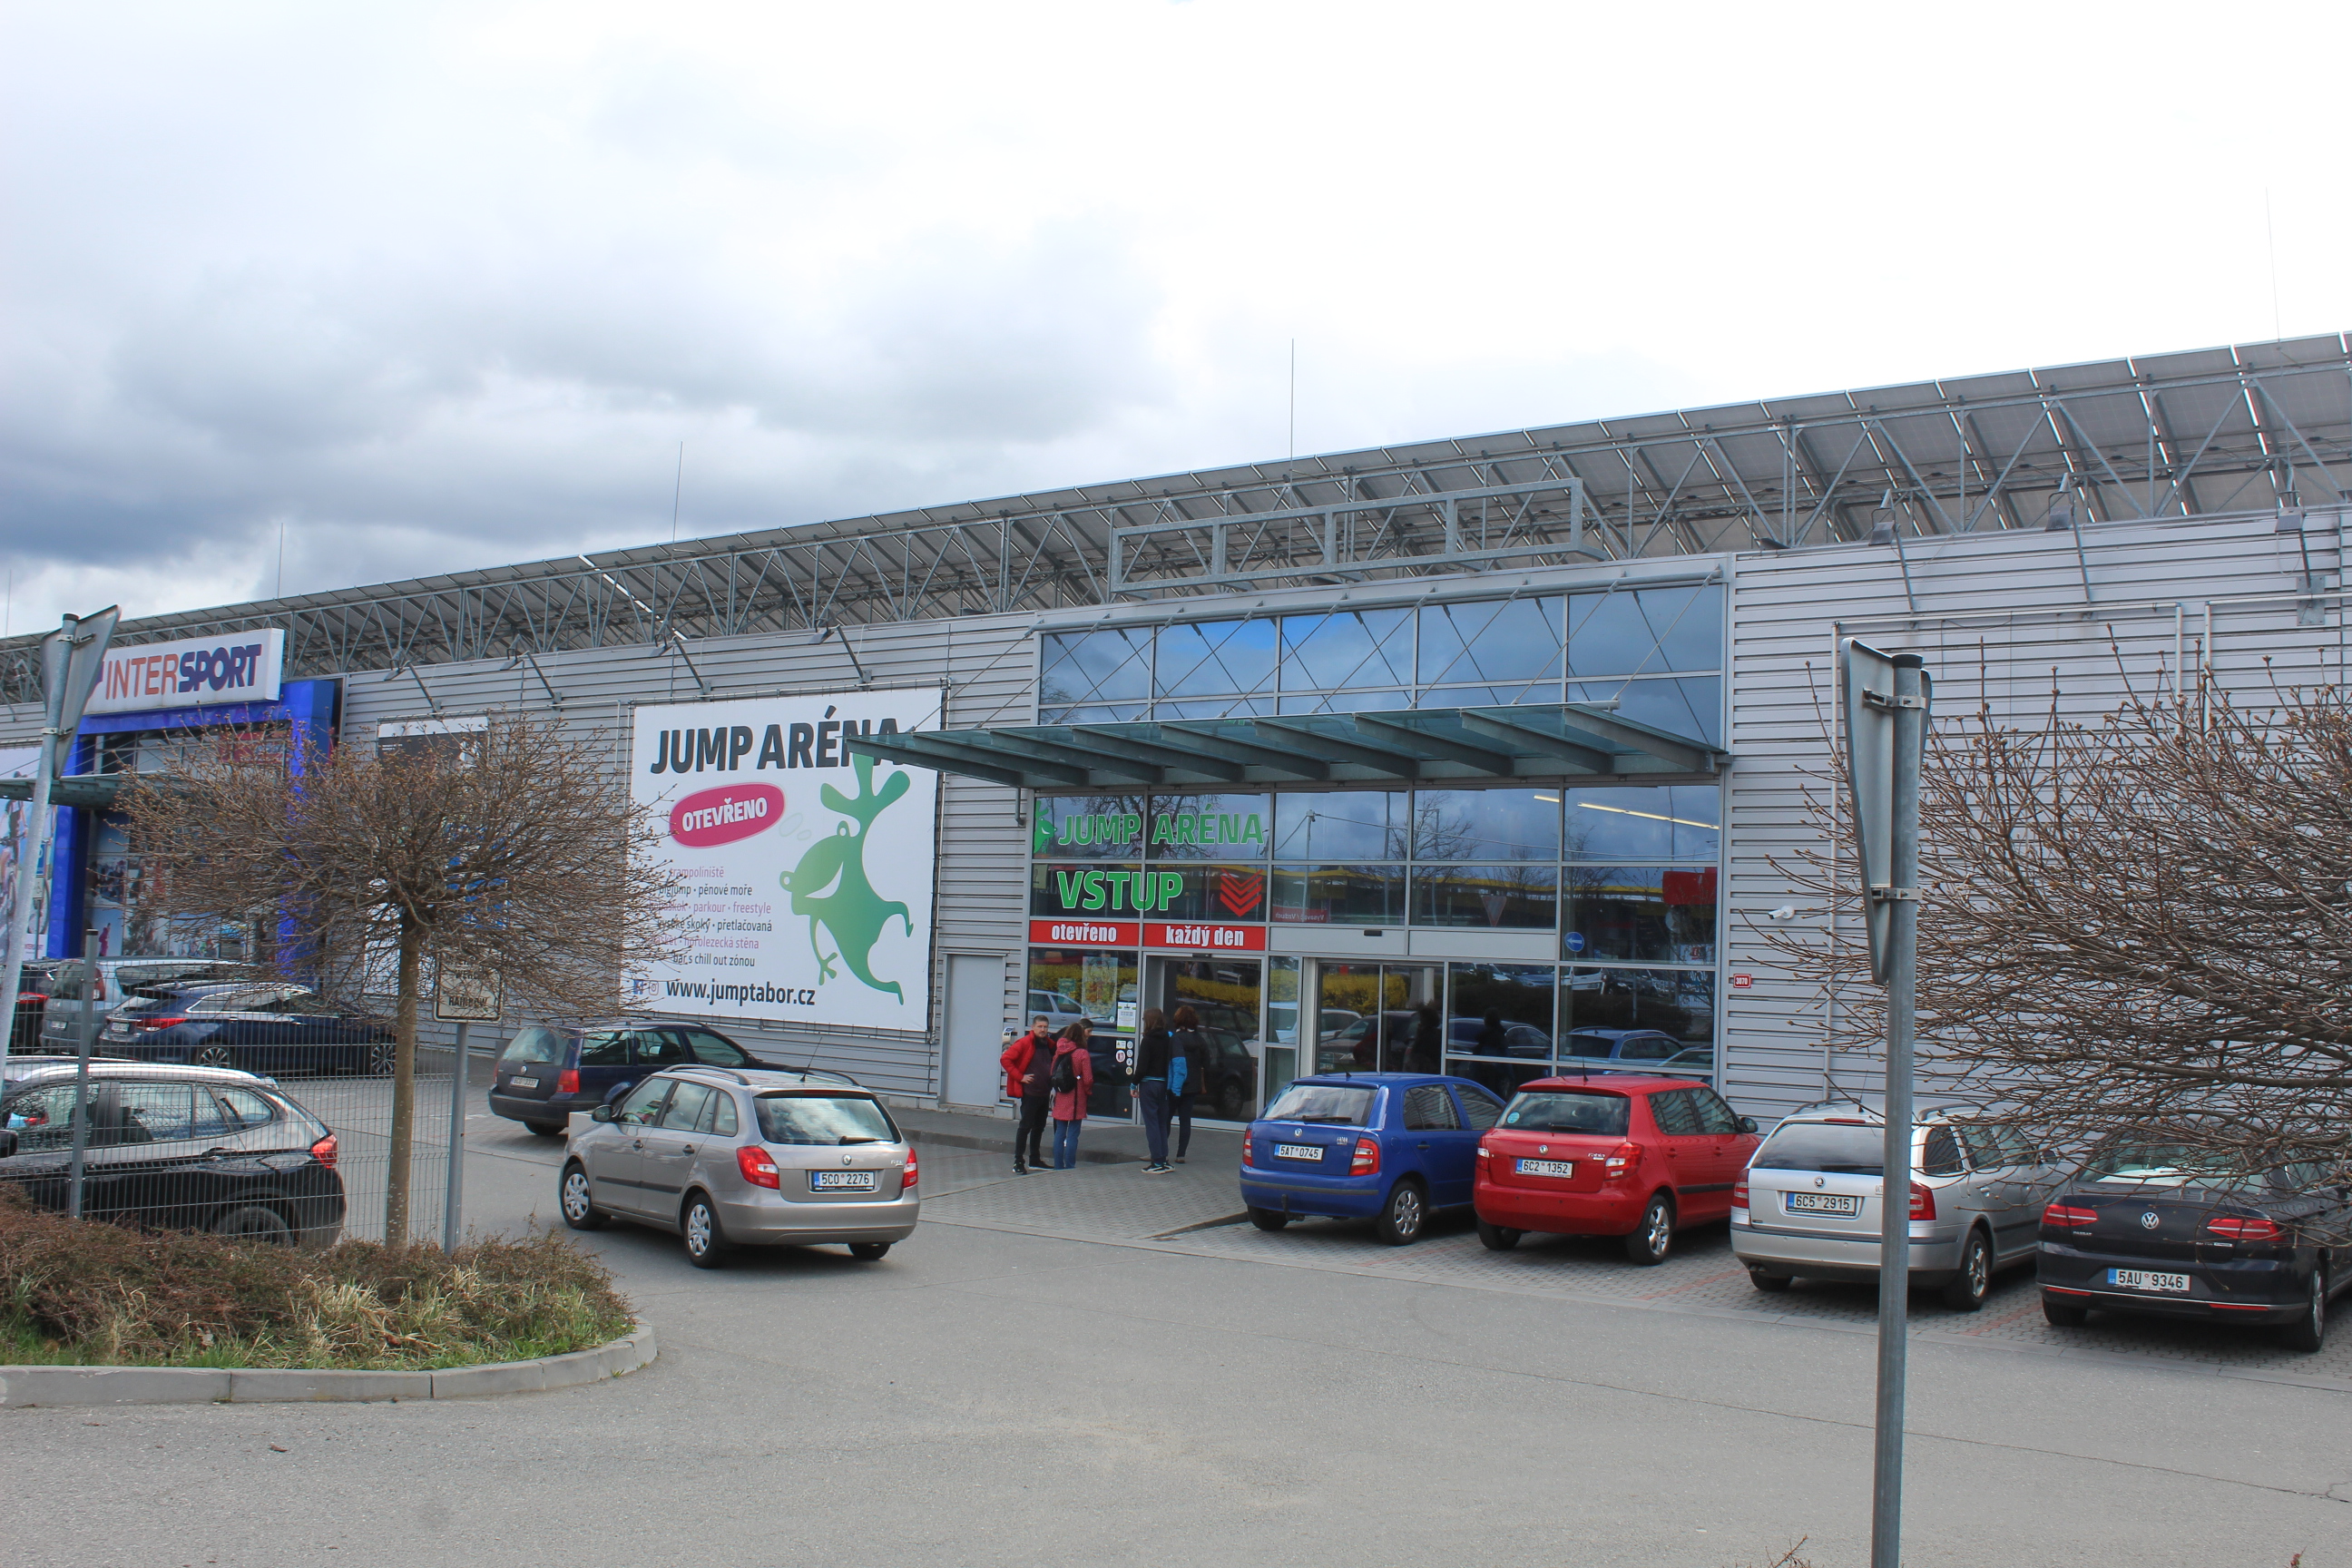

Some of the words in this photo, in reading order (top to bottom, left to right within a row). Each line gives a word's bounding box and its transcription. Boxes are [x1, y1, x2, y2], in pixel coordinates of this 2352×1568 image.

[105, 643, 262, 700] INTERSPORT
[650, 725, 753, 774] JUMP
[682, 796, 768, 832] OTEVŘENO
[1058, 813, 1141, 846] JUMP
[1152, 803, 1264, 845] ARÉNA
[698, 883, 729, 897] pěnové
[730, 883, 752, 896] moře
[1056, 870, 1183, 911] VSTUP
[693, 901, 726, 916] parkour
[733, 901, 771, 917] freestyle
[687, 918, 710, 933] skoky
[717, 918, 772, 934] přetlačovaná
[1052, 923, 1117, 942] otevřeno
[736, 936, 760, 949] stěna
[1166, 926, 1210, 947] každý
[1214, 926, 1244, 946] den
[688, 956, 692, 964] s
[694, 953, 711, 965] chill
[713, 956, 727, 965] out
[730, 954, 755, 967] zónou
[1735, 977, 1748, 985] 3070
[666, 978, 816, 1006] www.jumptabor.cz
[1280, 1145, 1294, 1157] 5AT
[1299, 1148, 1318, 1159] 0745
[1524, 1161, 1539, 1171] 6C2
[1547, 1162, 1568, 1174] 1352
[821, 1173, 839, 1184] 5C0
[847, 1173, 870, 1185] 2276
[1796, 1195, 1815, 1207] 6C5
[1823, 1197, 1850, 1210] 2915
[2118, 1270, 2141, 1285] 5AU
[2151, 1274, 2183, 1289] 9346
